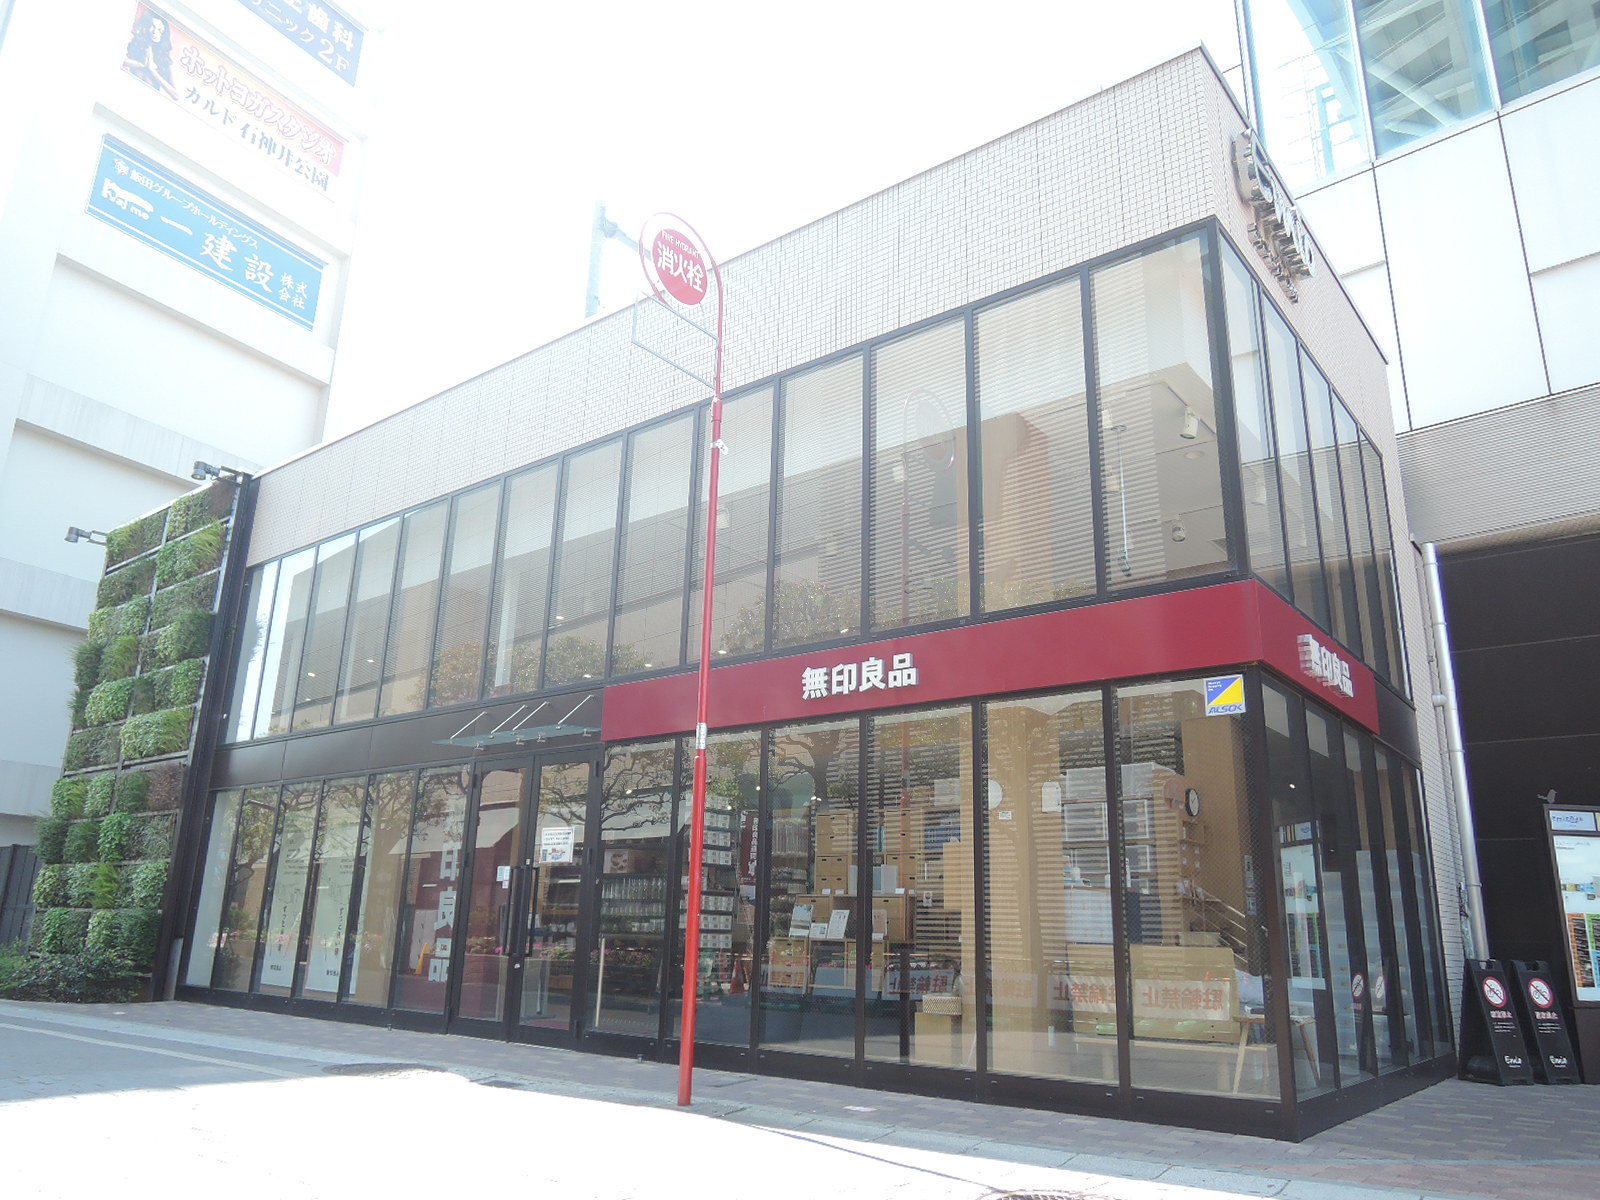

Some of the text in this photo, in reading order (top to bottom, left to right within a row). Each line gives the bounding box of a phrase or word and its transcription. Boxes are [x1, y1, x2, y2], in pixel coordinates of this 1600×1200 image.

[179, 46, 336, 165] ホットヨガスタジオ
[657, 240, 704, 293] 消火栓
[802, 653, 918, 700] 無印良品
[1298, 634, 1354, 698] 無印良品
[1208, 704, 1243, 714] ALSOK
